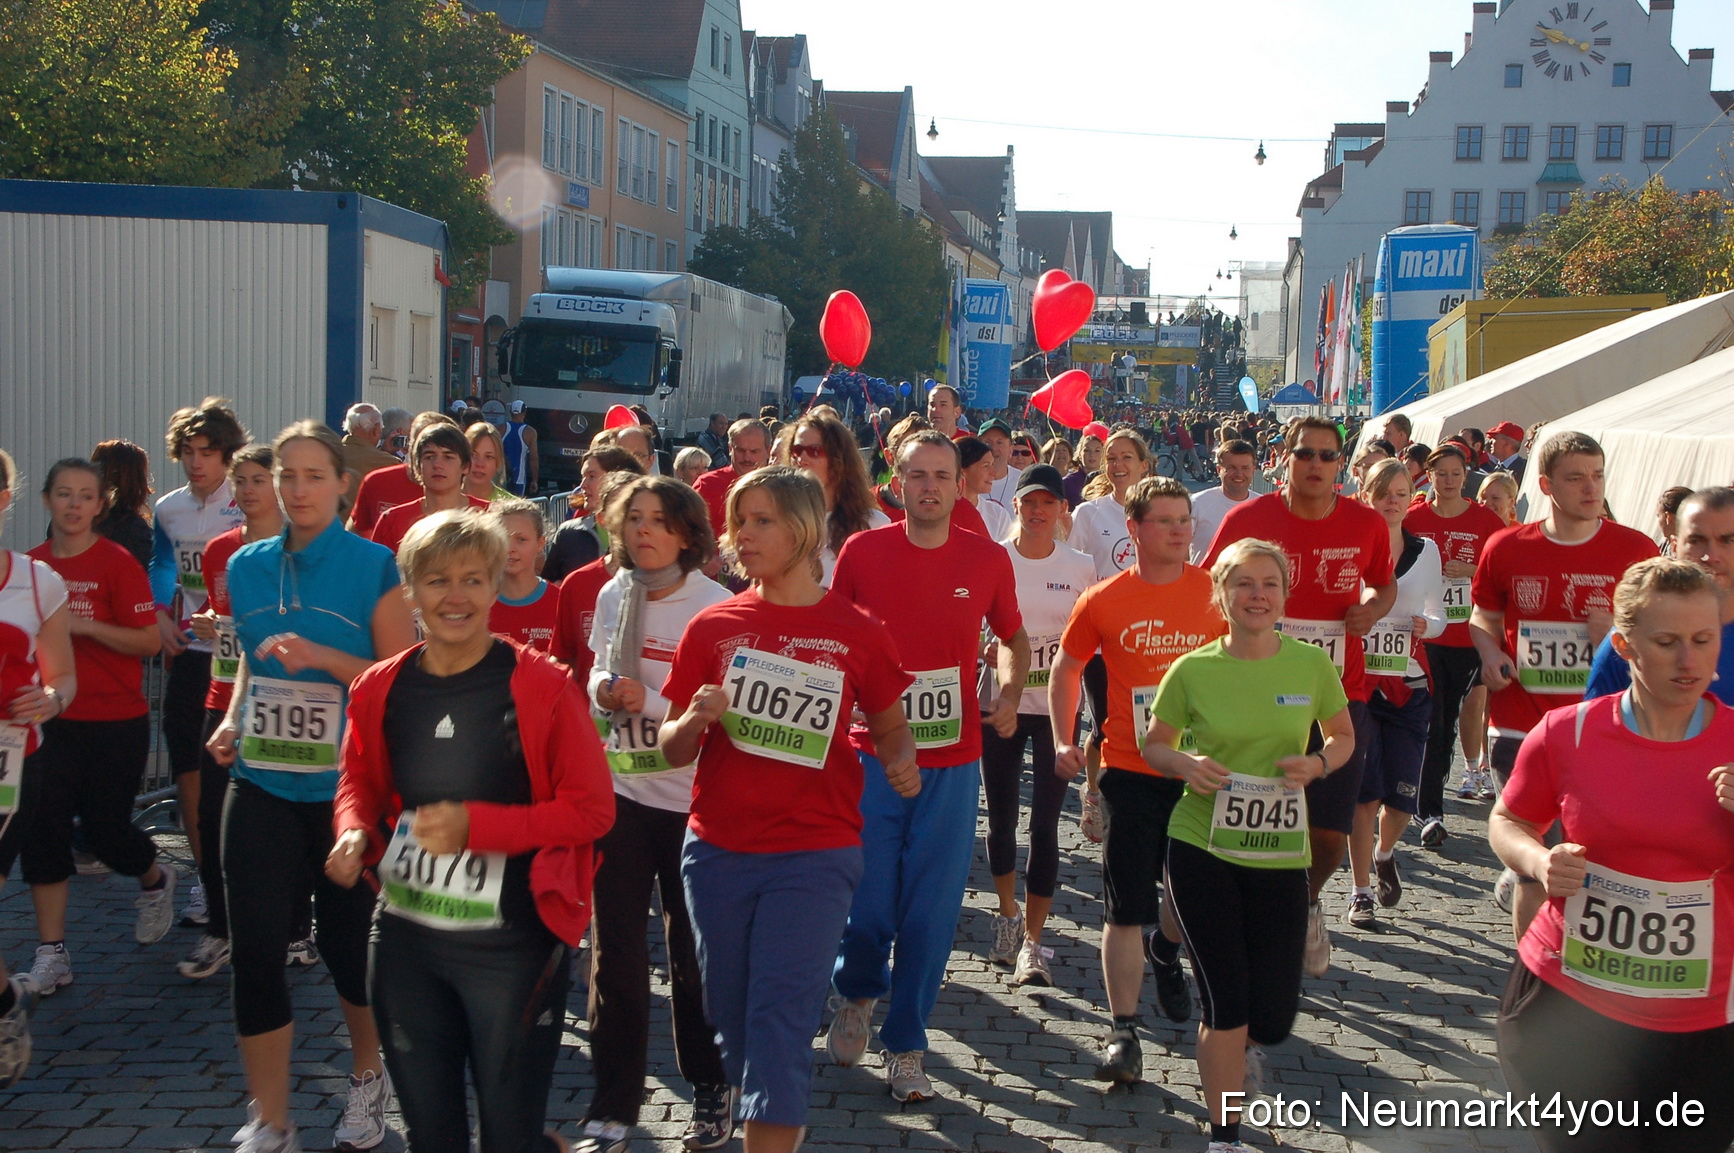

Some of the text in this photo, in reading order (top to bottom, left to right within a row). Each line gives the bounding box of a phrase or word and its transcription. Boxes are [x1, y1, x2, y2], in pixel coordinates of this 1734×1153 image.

[1397, 242, 1469, 279] maxi
[557, 298, 625, 315] BOCK
[977, 326, 996, 341] dsl
[1091, 329, 1139, 341] BOCK
[1134, 620, 1206, 649] Fischer
[747, 656, 796, 679] PFLEIDERER
[1368, 655, 1393, 669] Julia
[1526, 640, 1594, 669] 5134
[1537, 669, 1585, 684] Tobias
[730, 675, 833, 731] 10673
[252, 701, 327, 741] 5195
[737, 716, 805, 750] Sophia
[1233, 780, 1276, 793] PFLEIDERER
[1224, 795, 1300, 830] 5045
[1239, 832, 1280, 849] Julia
[394, 845, 489, 893] 5079
[1590, 874, 1651, 901] PFLEIDERER
[1665, 893, 1704, 905] BOCK
[1579, 894, 1696, 957] 5083
[1582, 944, 1688, 984] Stefanie
